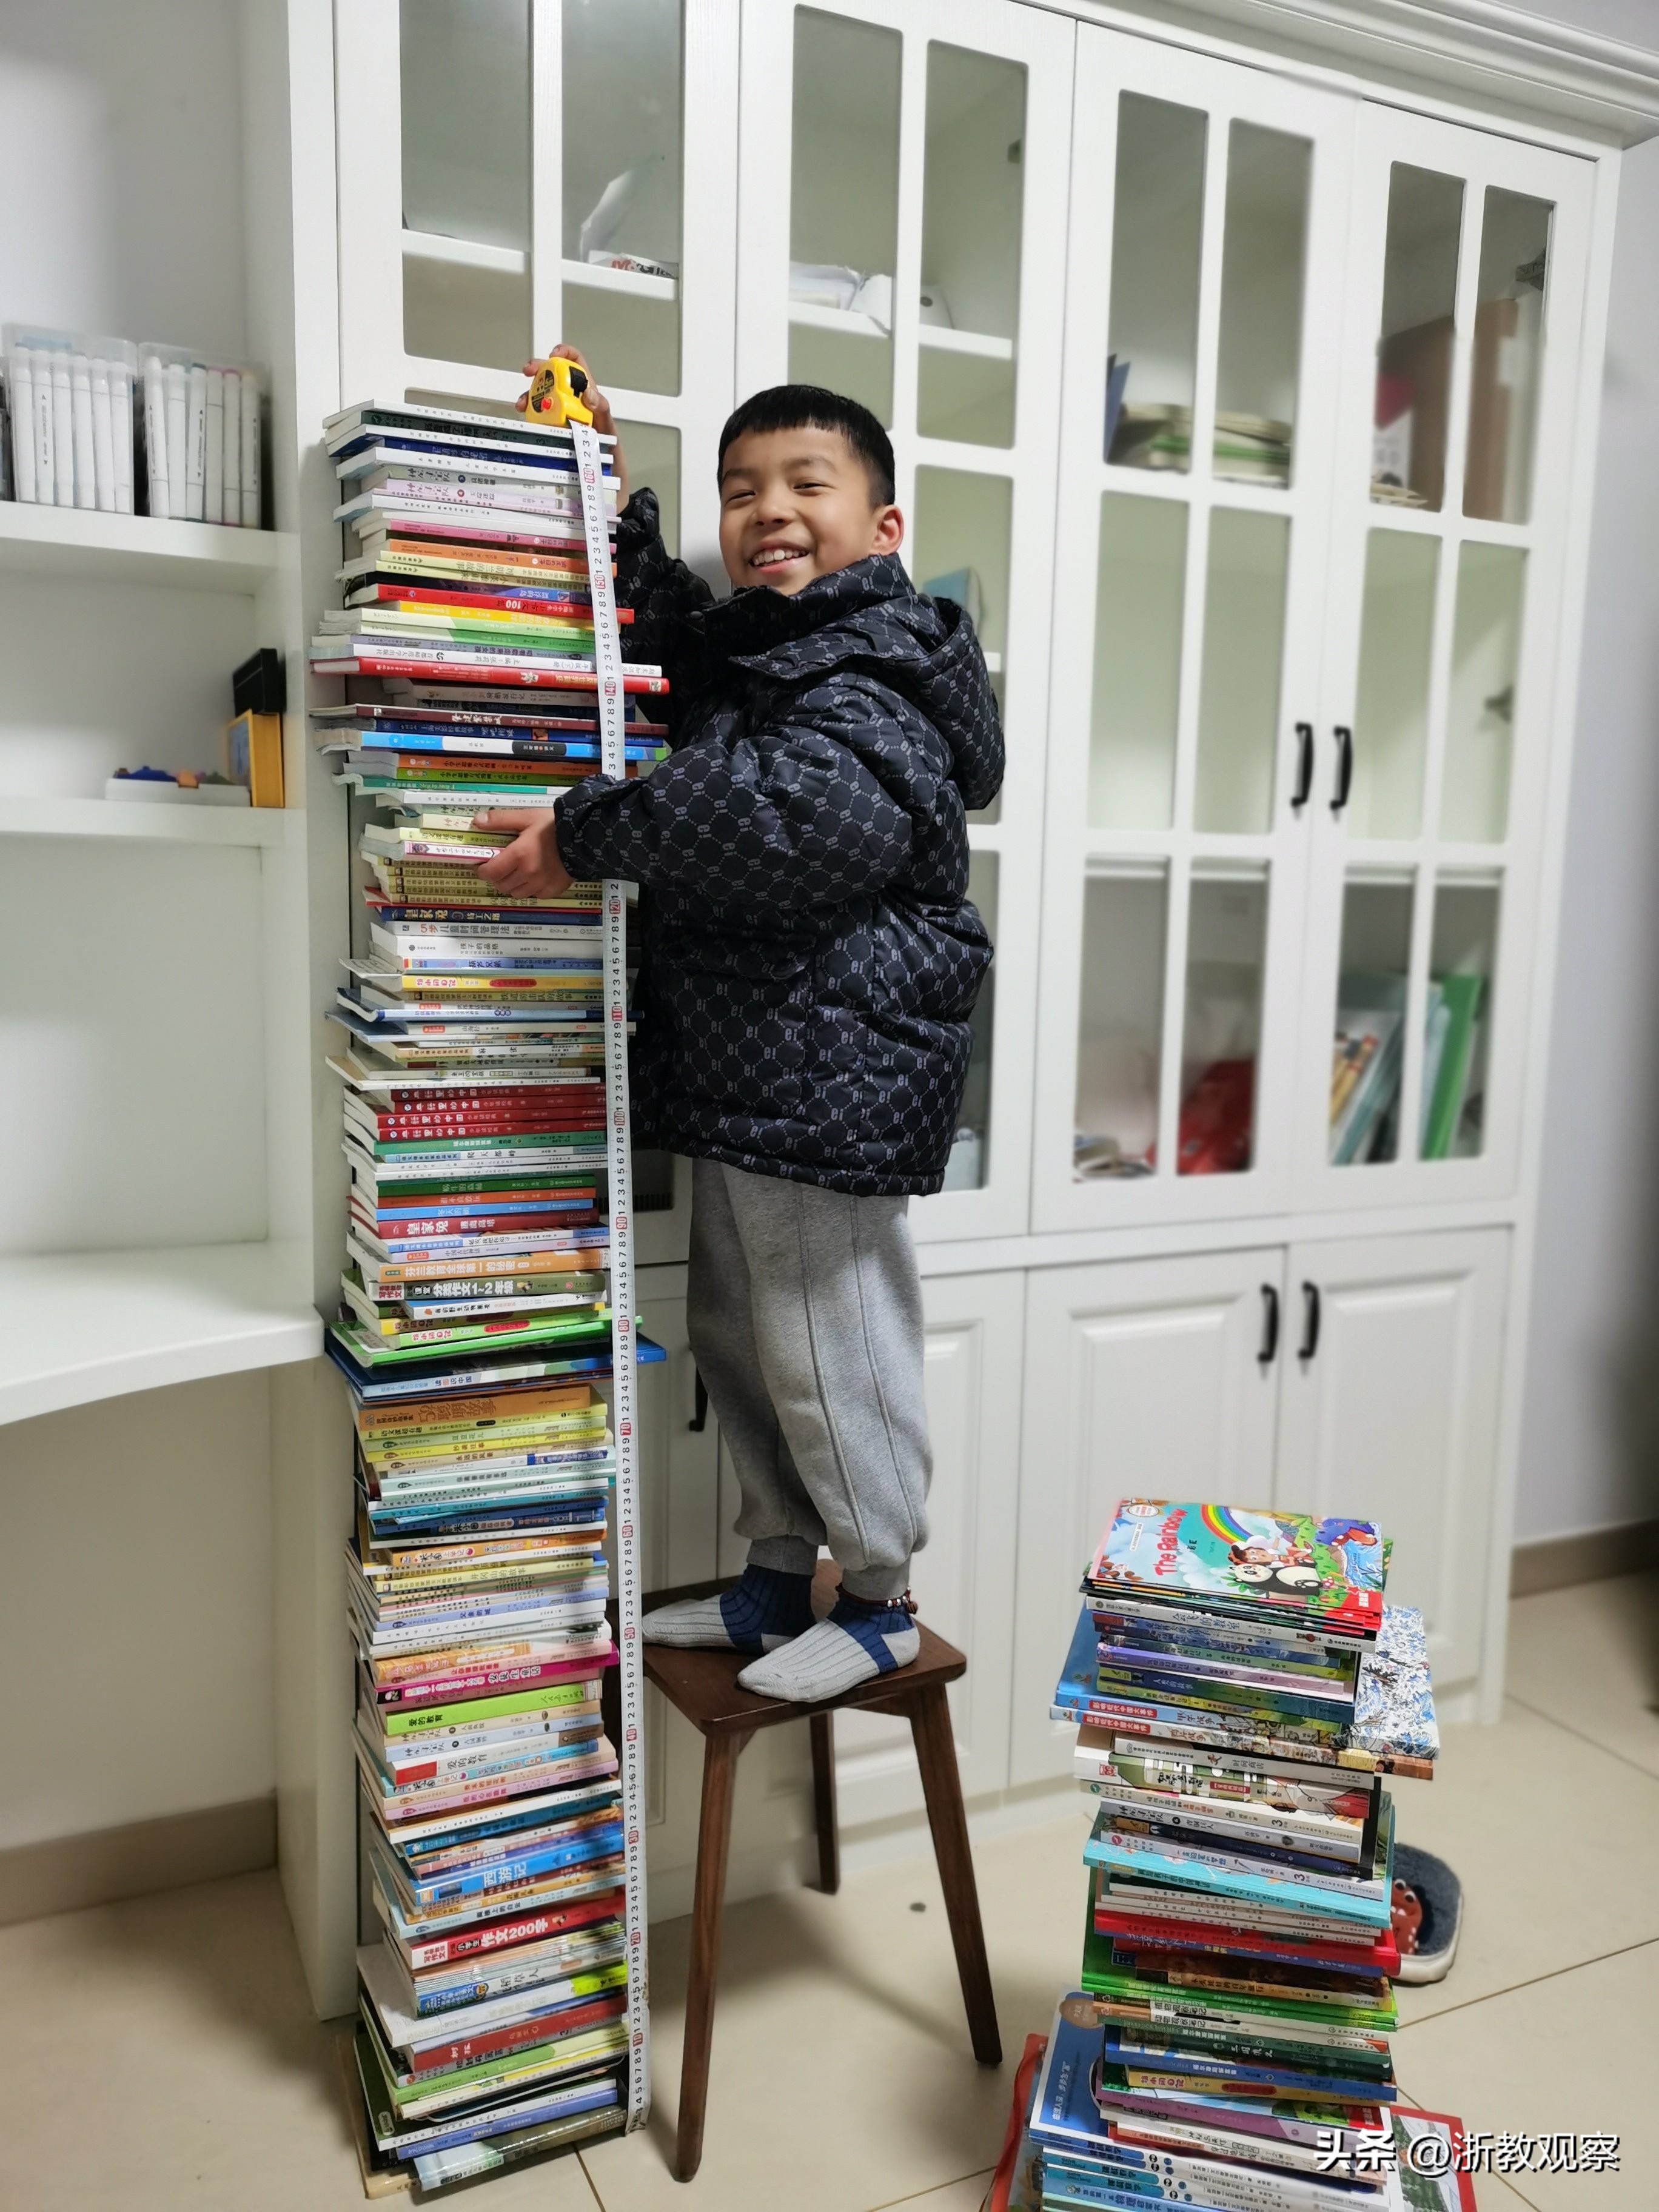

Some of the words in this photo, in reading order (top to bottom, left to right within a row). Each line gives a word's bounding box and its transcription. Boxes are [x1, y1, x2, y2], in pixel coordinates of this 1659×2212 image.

[584, 467, 594, 483] 160
[595, 575, 605, 589] 150
[605, 682, 615, 696] 140
[609, 900, 619, 914] 120
[612, 1005, 622, 1021] 110
[614, 1111, 623, 1125] 100
[407, 1220, 449, 1235] 皇家兔
[616, 1216, 625, 1229] 90
[404, 1260, 515, 1276] 芬兰教育全球第一的秘密
[432, 1279, 515, 1297] 分类作文1~2年级
[619, 1320, 628, 1332] 80
[620, 1423, 630, 1435] 70
[622, 1525, 632, 1537] 60
[1155, 1507, 1188, 1552] Rainbow
[1153, 1551, 1178, 1577] The
[1171, 1612, 1241, 1631] 会飞的教室
[625, 1627, 634, 1640] 50
[488, 1665, 541, 1684] 安徒生童话
[408, 1714, 443, 1727] 爱的教育
[626, 1729, 635, 1741] 40
[1272, 1818, 1283, 1828] 3
[629, 1831, 638, 1844] 30
[483, 1862, 527, 1886] 西游记
[1293, 1872, 1305, 1883] 3
[480, 1919, 549, 1944] 作文200字
[631, 1932, 639, 1945] 20
[634, 2034, 642, 2046] 10
